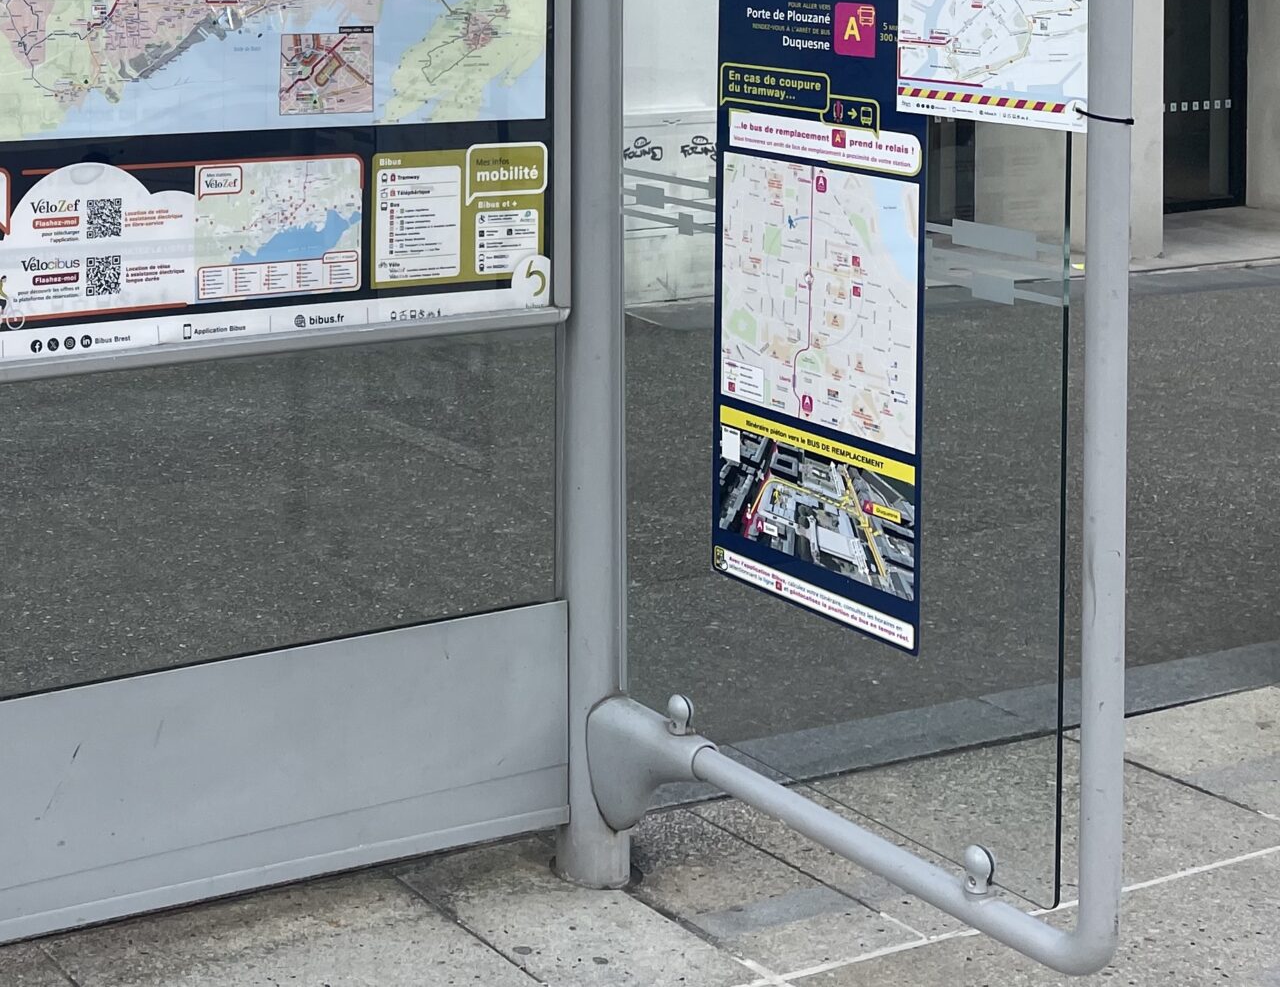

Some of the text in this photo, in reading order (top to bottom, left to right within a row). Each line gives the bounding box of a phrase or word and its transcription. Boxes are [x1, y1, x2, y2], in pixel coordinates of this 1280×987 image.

[747, 8, 830, 23] Porte de Plouzané
[844, 17, 860, 41] A
[782, 36, 829, 50] Duquesne
[729, 71, 821, 91] En cas de coupure
[729, 82, 740, 92] du
[750, 124, 762, 132] bus
[765, 125, 773, 133] de
[776, 127, 829, 142] remplacement
[850, 138, 872, 150] prend
[876, 141, 882, 150] le
[886, 143, 908, 154] relais
[477, 165, 538, 182] mobilité
[30, 199, 80, 214] VéloZef
[21, 257, 80, 271] Vélocibus
[309, 314, 344, 325] bibus.fr
